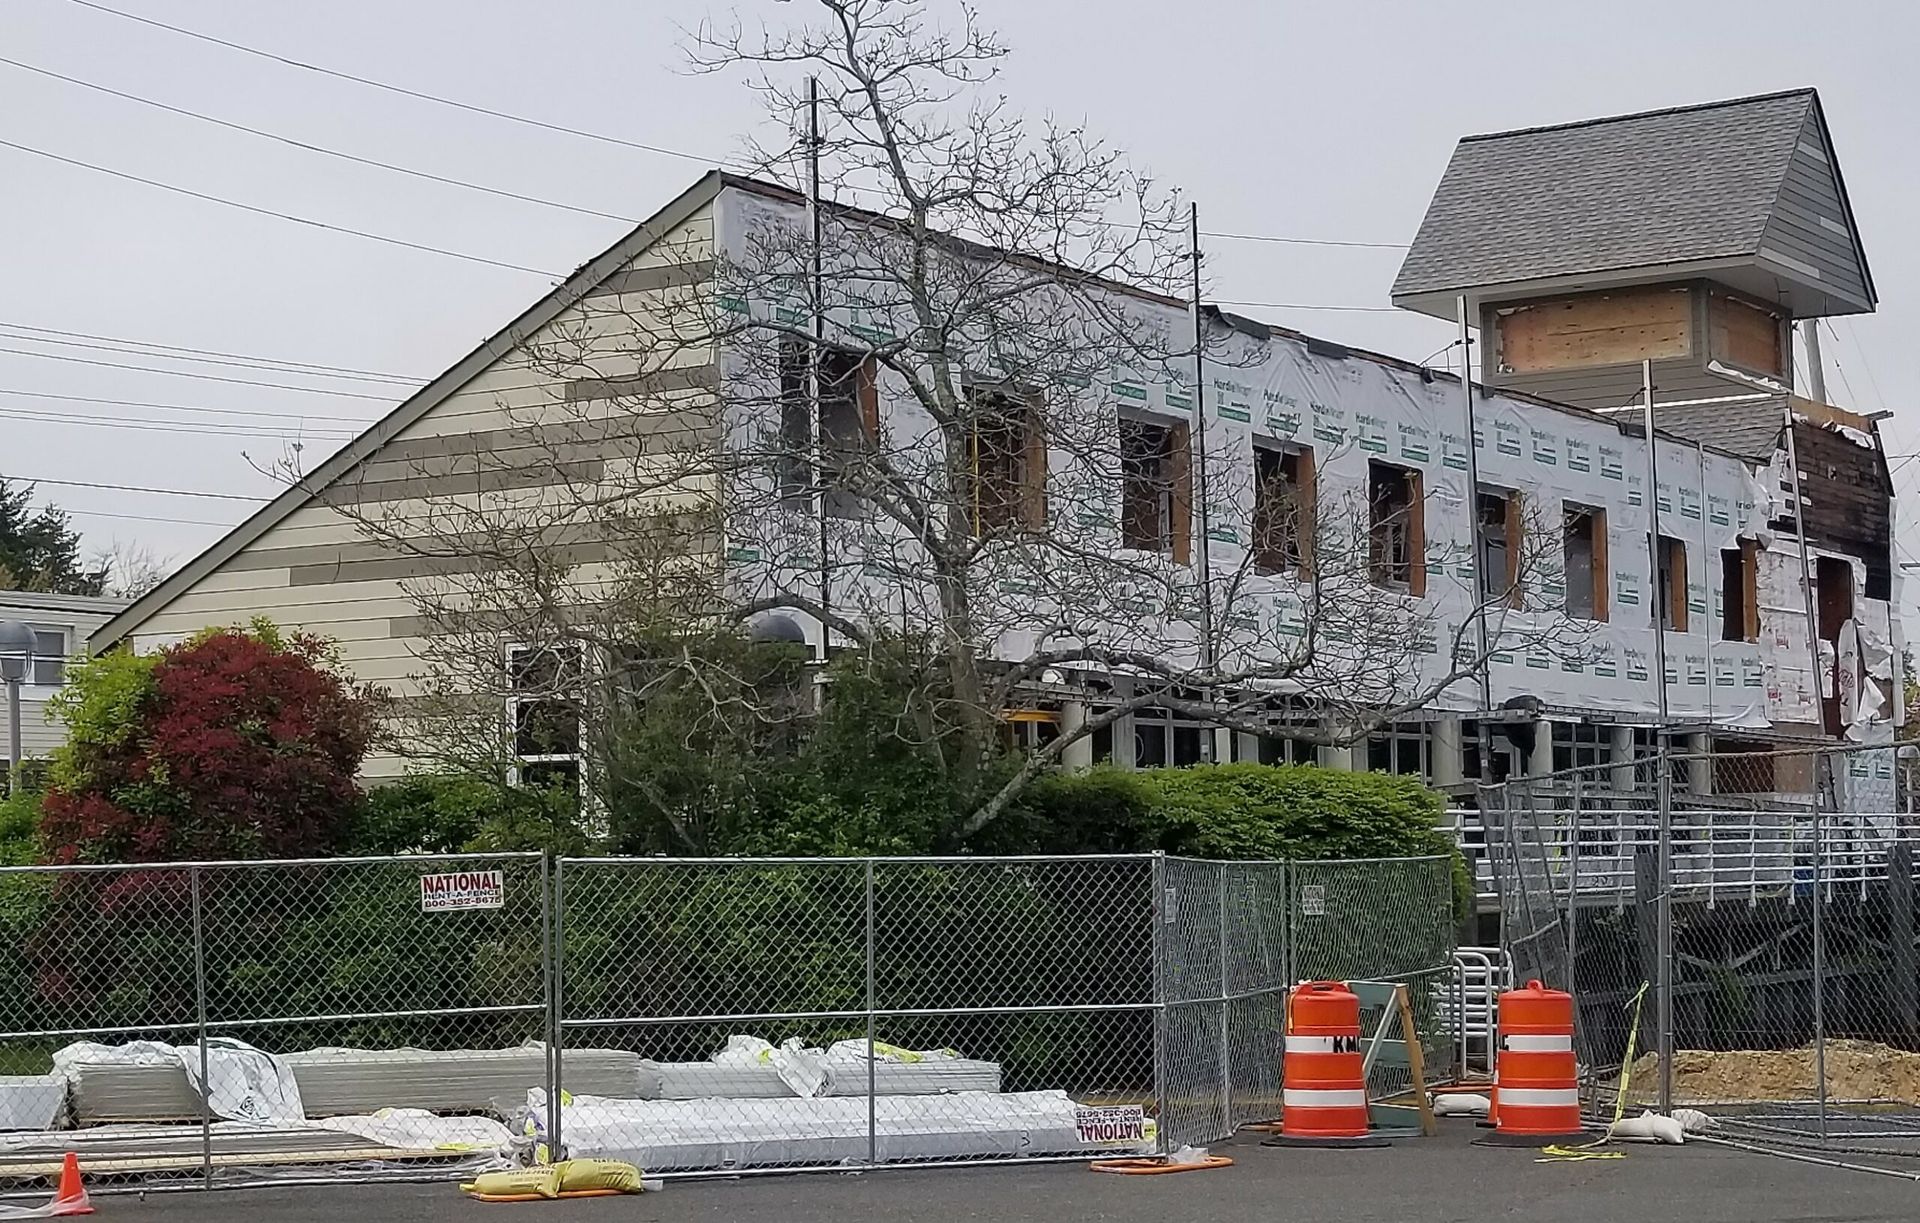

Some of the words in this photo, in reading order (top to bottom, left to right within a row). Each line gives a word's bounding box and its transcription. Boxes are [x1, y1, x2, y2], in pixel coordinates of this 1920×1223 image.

[423, 872, 501, 893] NATIONAL
[424, 889, 500, 900] RENT-A-FENCE
[1077, 1122, 1144, 1141] NATIONAL
